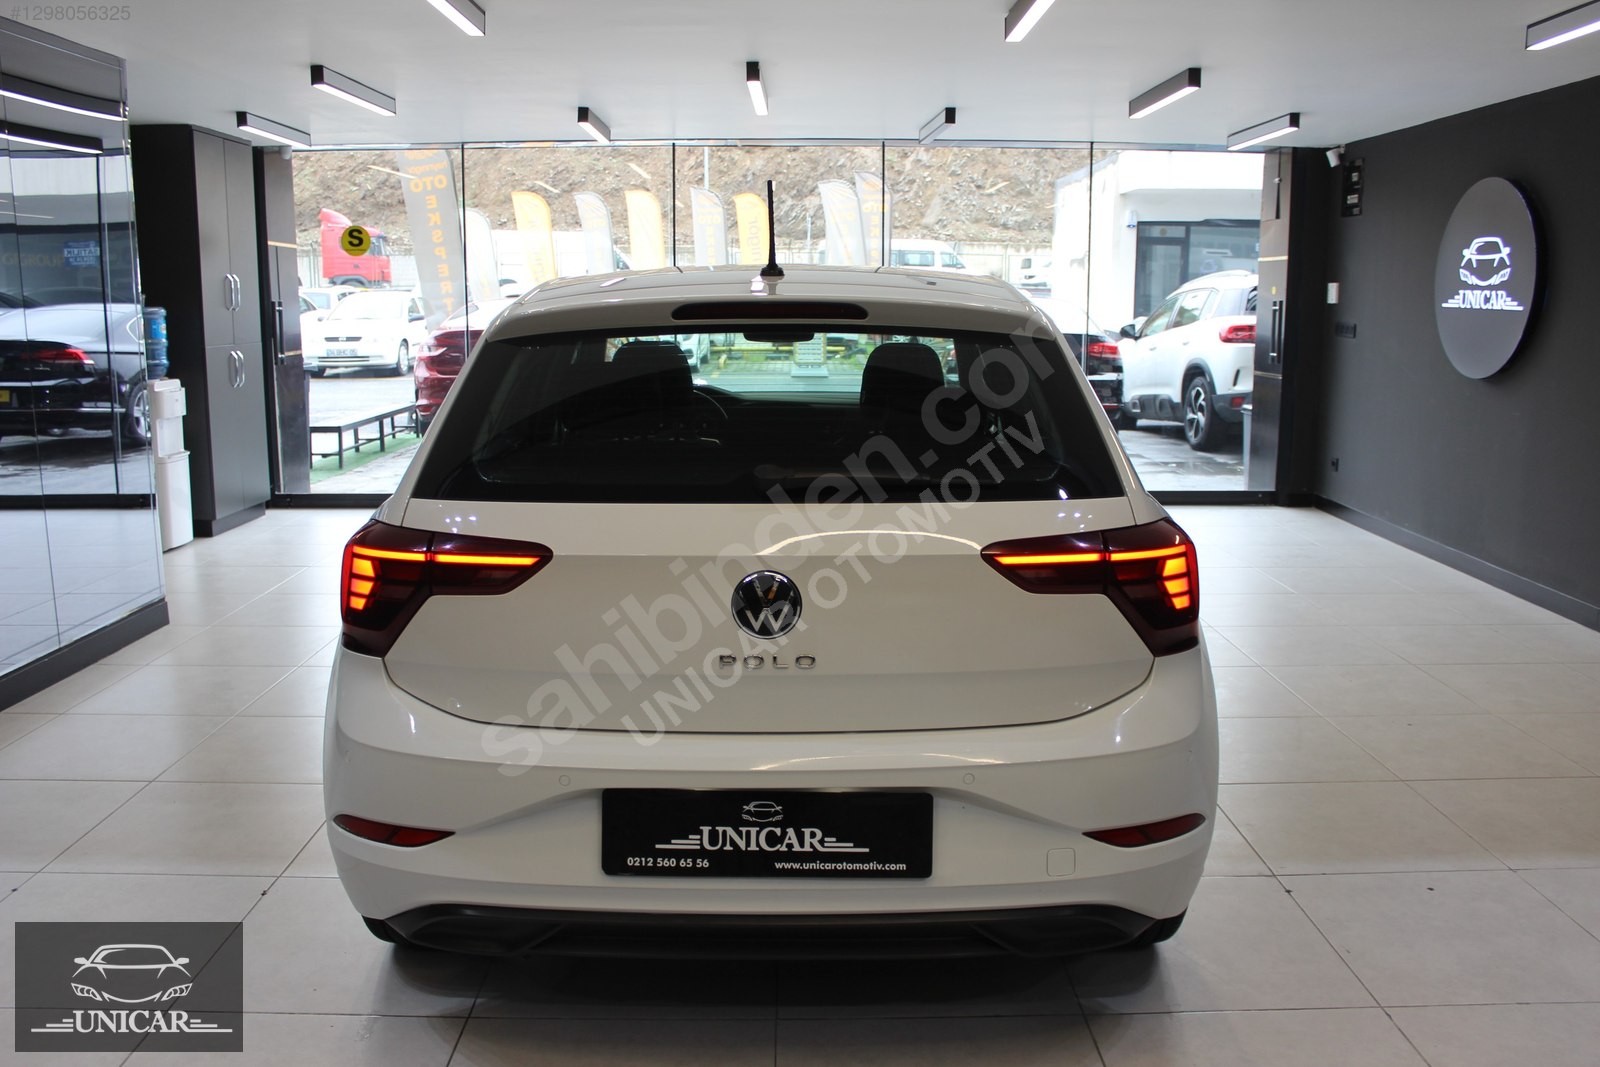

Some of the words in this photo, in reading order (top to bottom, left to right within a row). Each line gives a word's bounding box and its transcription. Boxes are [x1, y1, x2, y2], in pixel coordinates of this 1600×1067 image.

[348, 229, 363, 247] S
[1458, 290, 1507, 310] UNICAR
[719, 654, 817, 669] POLO
[700, 826, 824, 852] UNICAR
[627, 857, 653, 866] 0212
[656, 858, 676, 867] 560
[680, 858, 693, 867] 65
[696, 859, 710, 868] 56
[774, 860, 906, 870] www.unicarotomotiv.com
